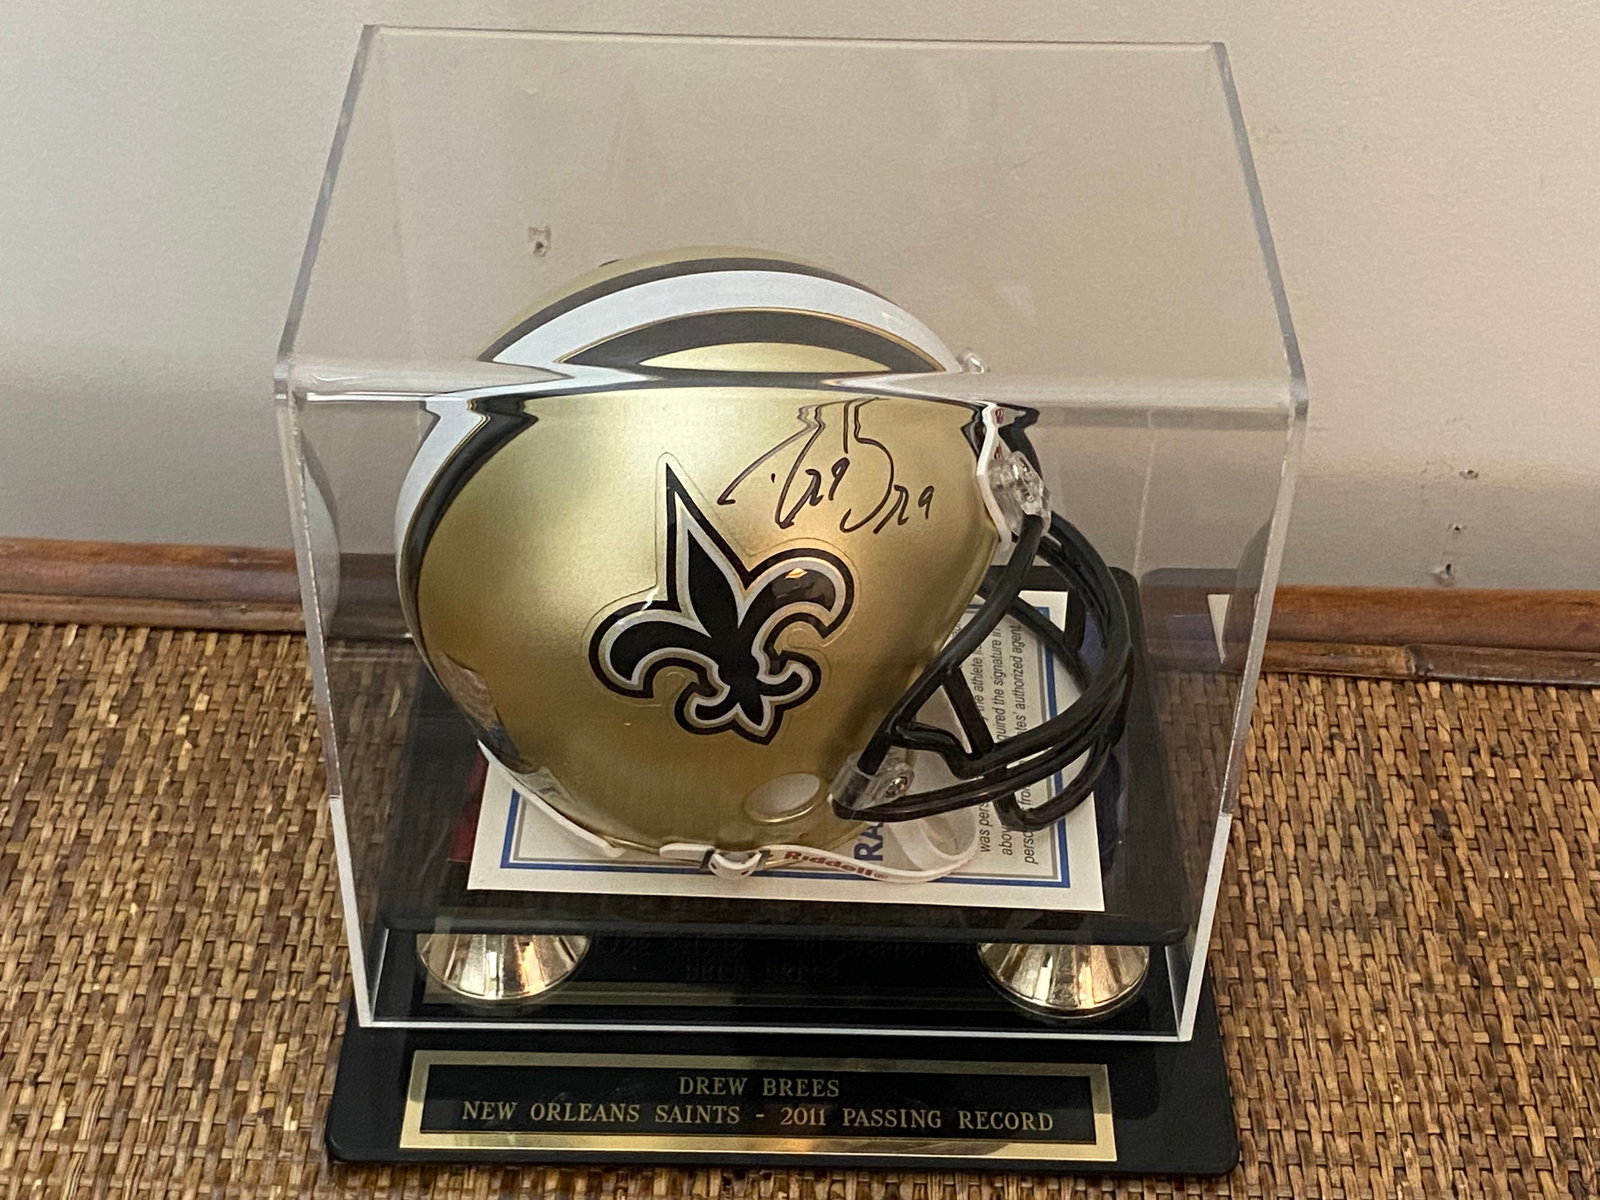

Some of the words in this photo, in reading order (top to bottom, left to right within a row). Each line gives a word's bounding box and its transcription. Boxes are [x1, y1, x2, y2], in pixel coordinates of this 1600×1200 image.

[970, 657, 985, 692] athlete
[990, 639, 1006, 686] signature
[992, 689, 1005, 705] the
[1009, 656, 1025, 710] authorized
[979, 829, 990, 853] was
[679, 1076, 748, 1095] DREW
[763, 1077, 840, 1098] BREES
[462, 1101, 518, 1121] NEW
[530, 1102, 641, 1123] ORLEANS
[655, 1104, 741, 1124] SAINTS
[780, 1107, 826, 1126] 2011
[842, 1108, 942, 1130] PASSING
[958, 1110, 1054, 1131] RECORD
